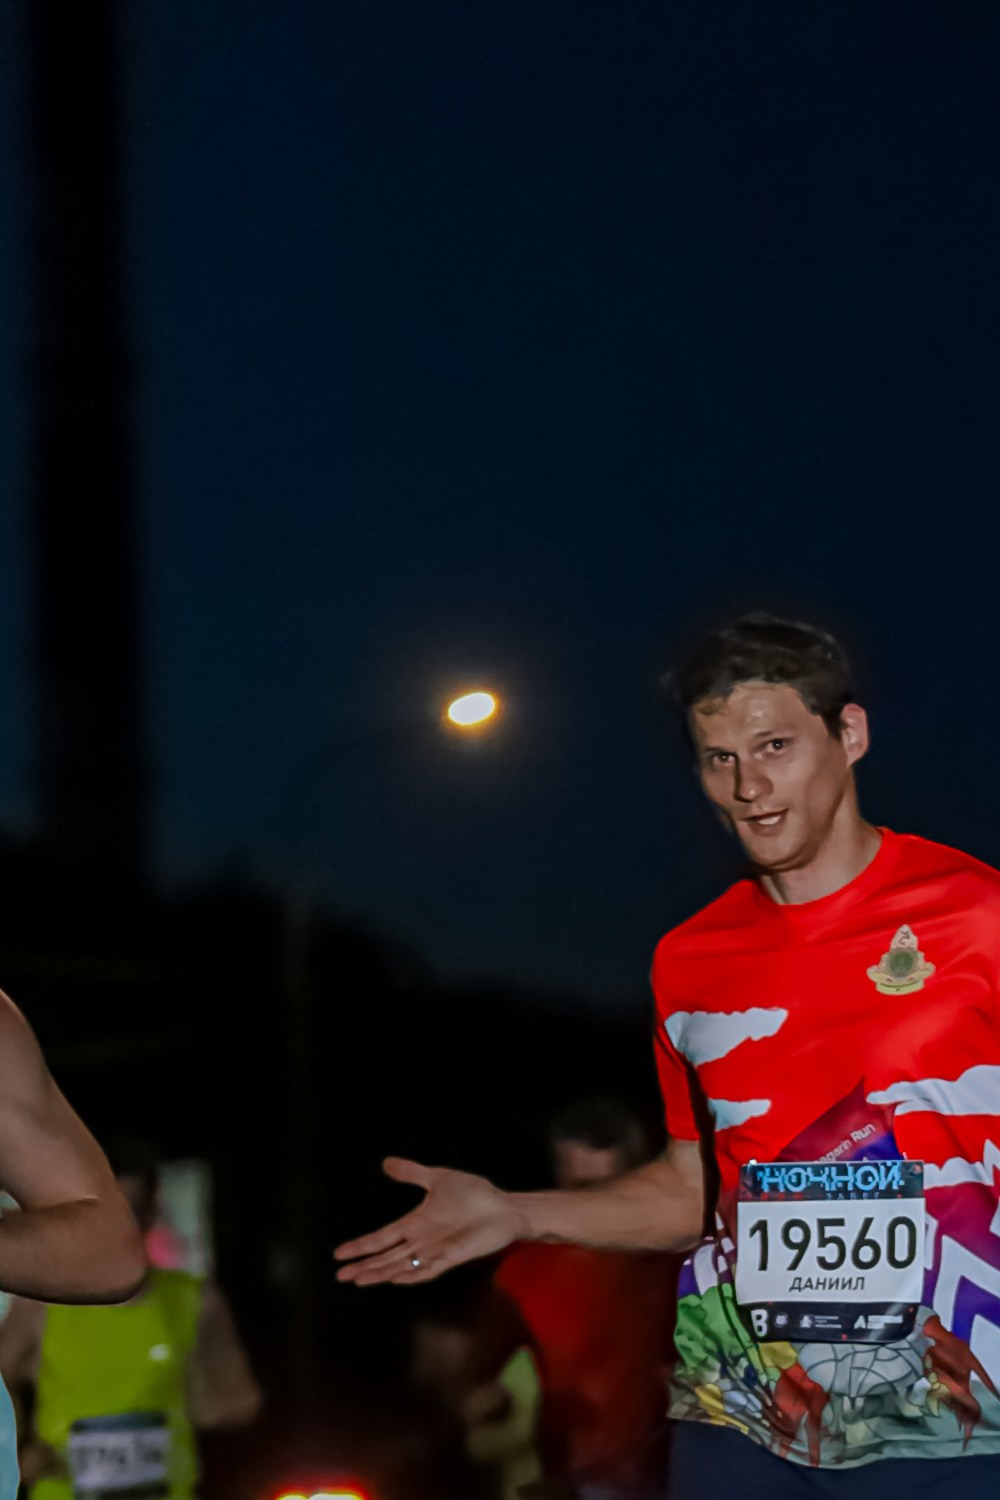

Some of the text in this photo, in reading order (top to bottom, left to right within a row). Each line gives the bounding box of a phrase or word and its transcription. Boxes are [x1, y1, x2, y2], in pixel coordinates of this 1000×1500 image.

[850, 1123, 876, 1143] Run
[758, 1162, 905, 1193] НОЧНОЙ
[749, 1216, 916, 1271] 19560
[788, 1276, 865, 1292] ДАНИИЛ
